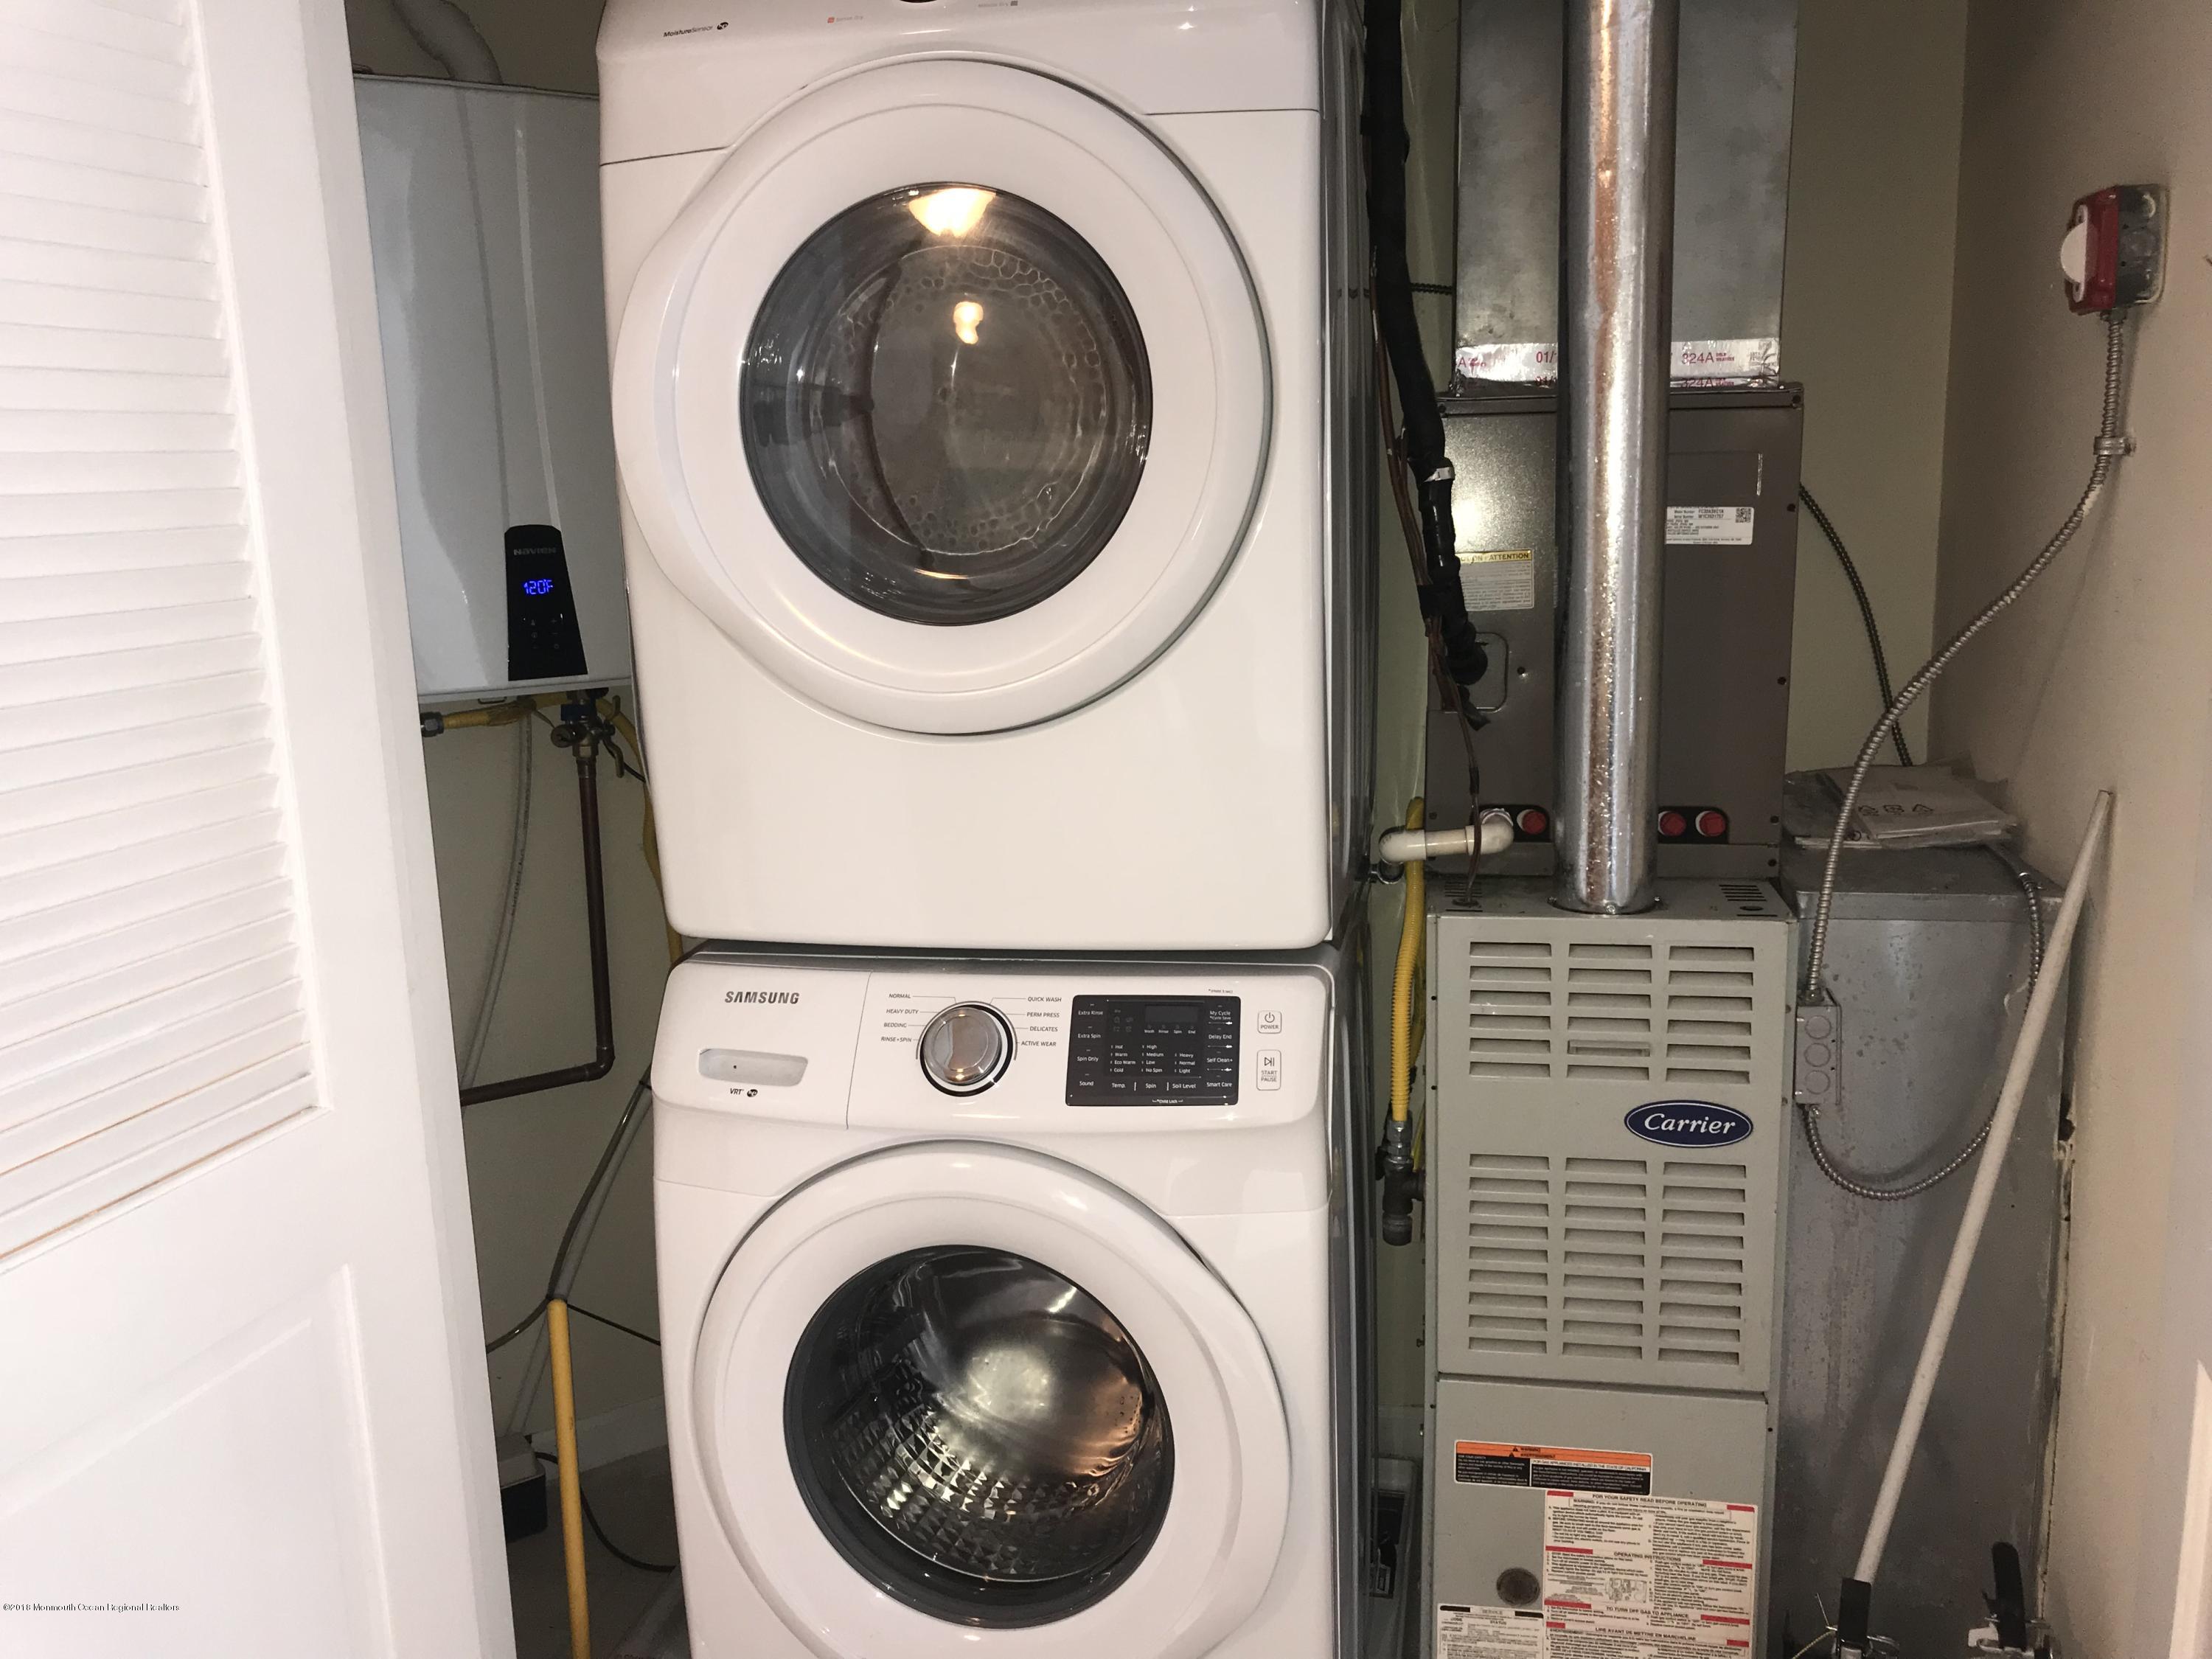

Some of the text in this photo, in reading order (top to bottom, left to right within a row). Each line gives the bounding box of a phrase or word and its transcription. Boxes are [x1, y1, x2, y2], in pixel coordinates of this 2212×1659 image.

[1536, 351, 1557, 364] 01/
[724, 991, 800, 1004] SAMSUNG
[1644, 1113, 1736, 1134] Carrier
